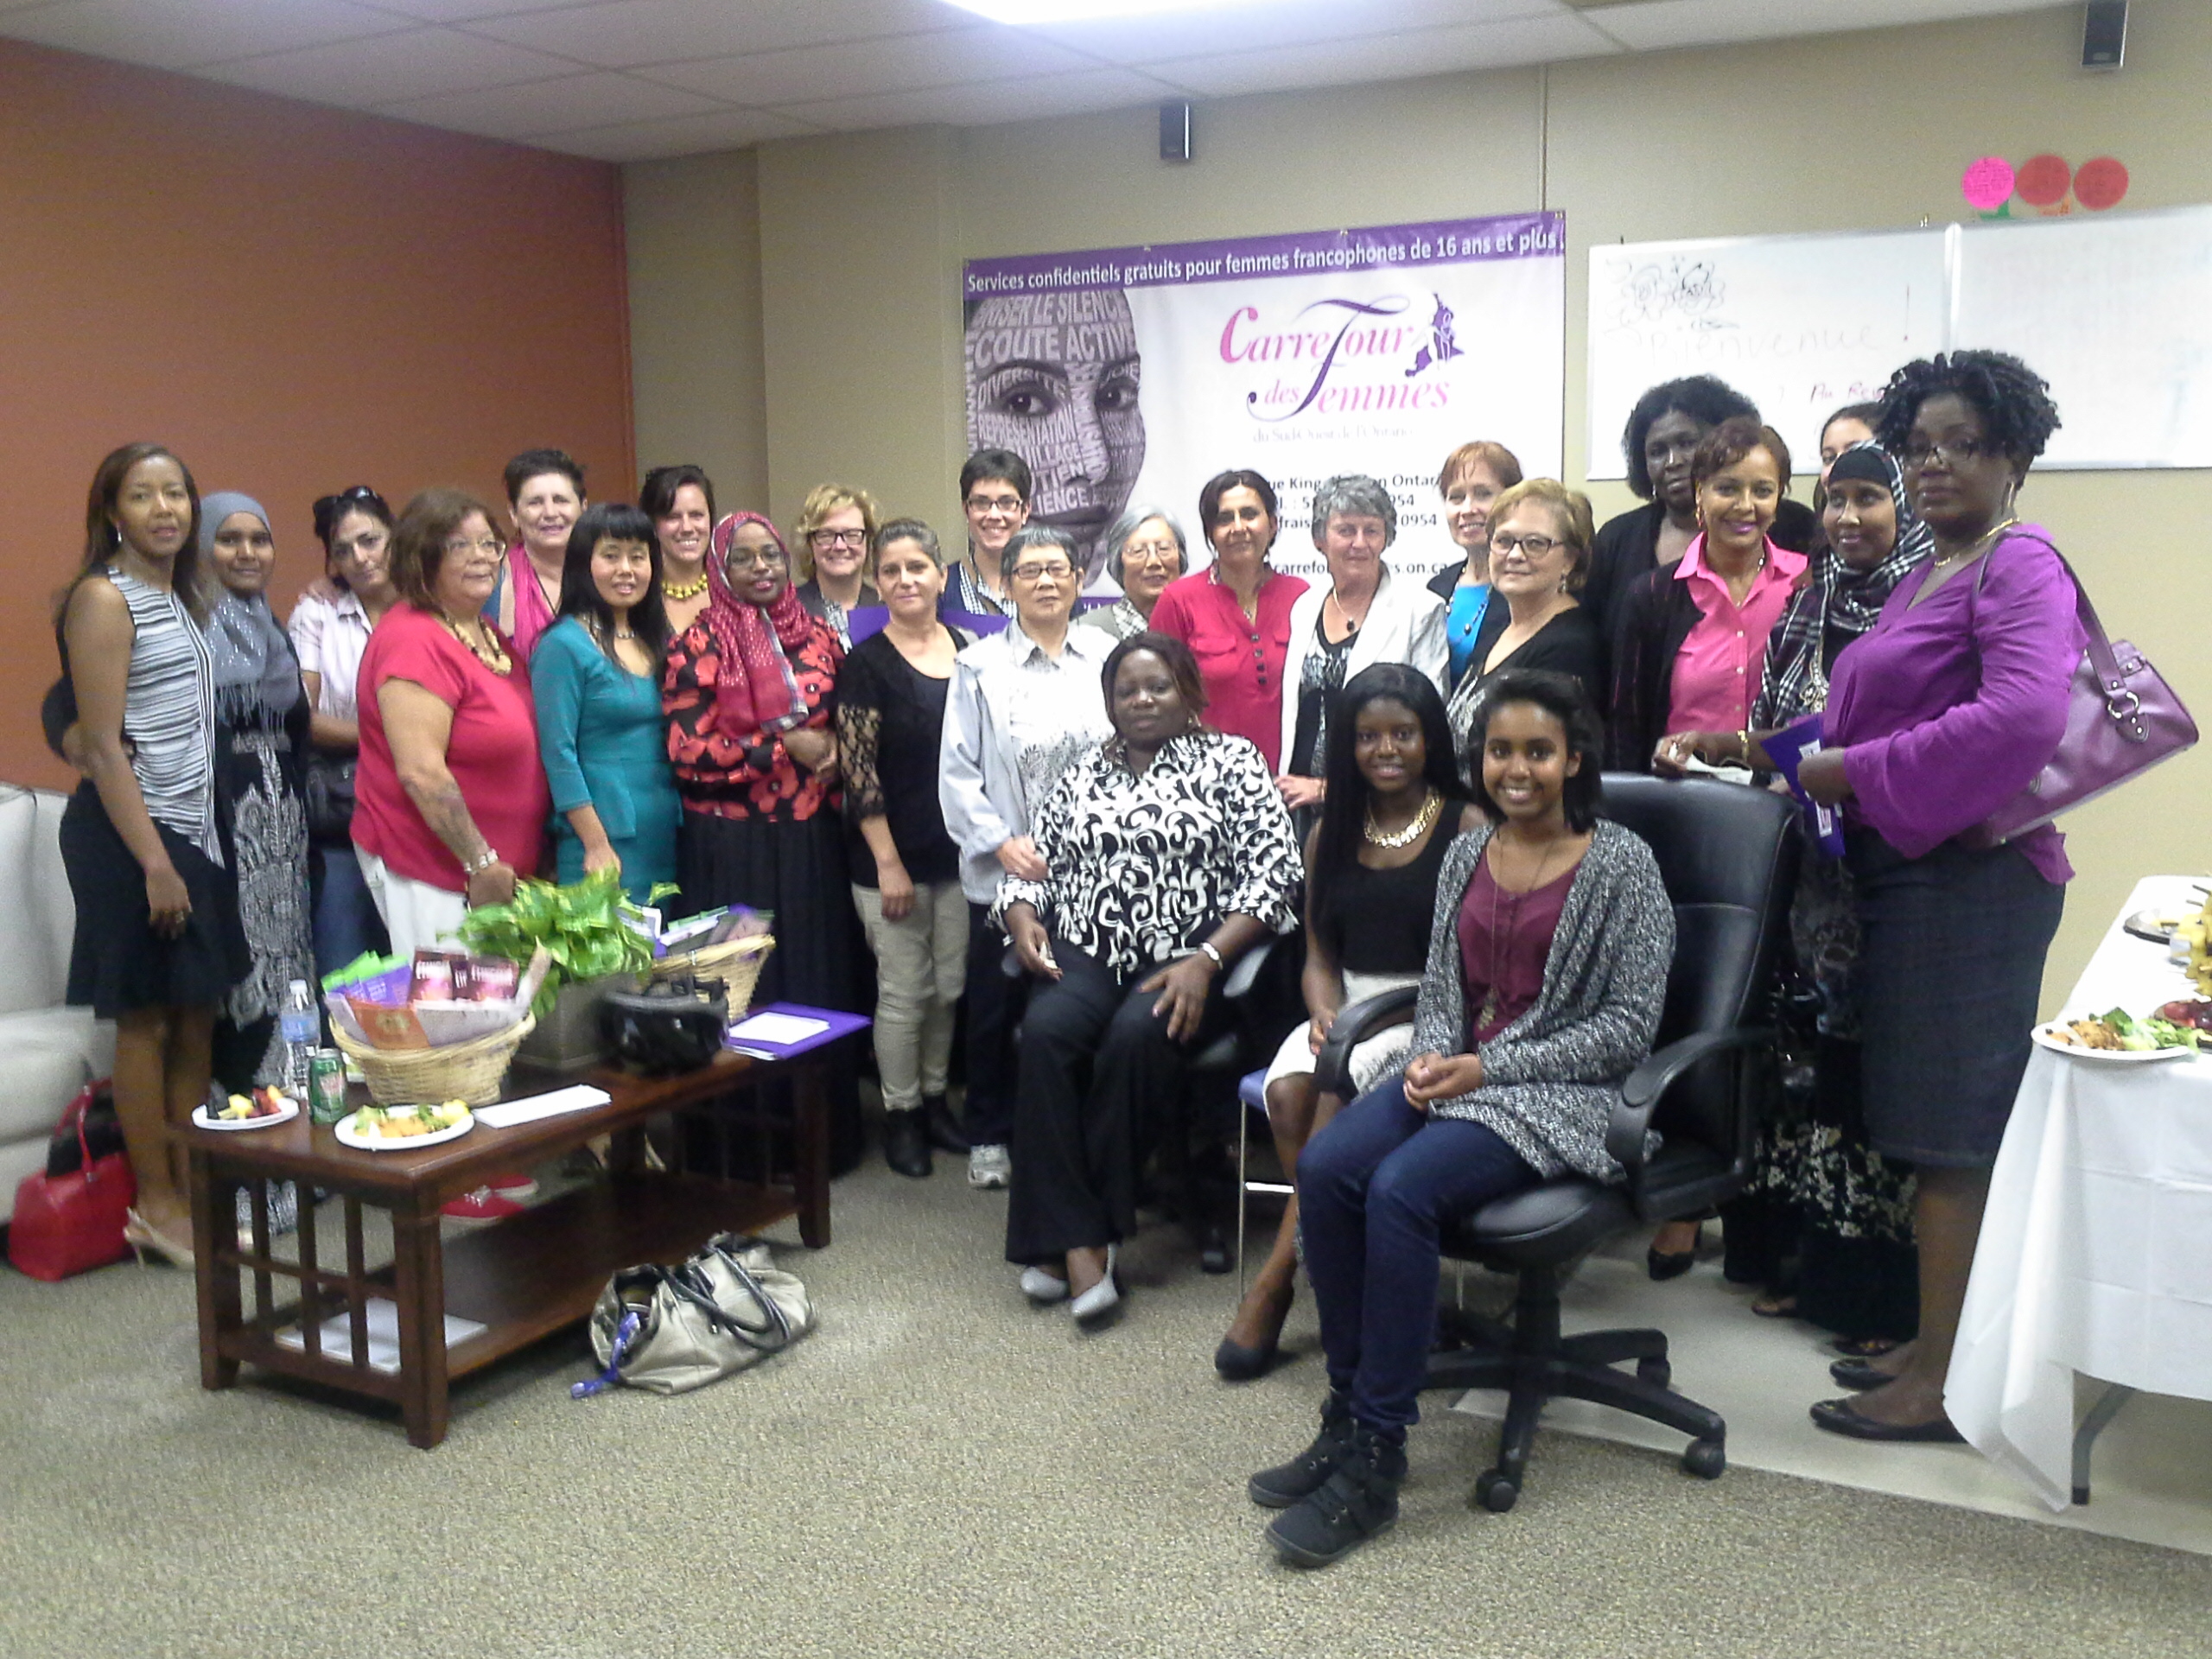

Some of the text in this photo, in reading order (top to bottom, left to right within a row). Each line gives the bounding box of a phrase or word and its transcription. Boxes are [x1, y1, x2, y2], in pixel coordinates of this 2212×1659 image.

[968, 271, 1024, 292] Services
[1028, 263, 1121, 288] confidentiels
[1124, 258, 1181, 285] gratuits
[1185, 259, 1222, 281] pour
[1226, 253, 1289, 273] femmes
[1294, 243, 1406, 270] francophones
[1410, 237, 1431, 259] de
[1437, 235, 1457, 257] 16
[1462, 237, 1491, 255] ans
[1496, 232, 1514, 252] et
[1264, 379, 1300, 404] des
[1392, 473, 1437, 487] Ontar
[1401, 513, 1437, 527] 0954
